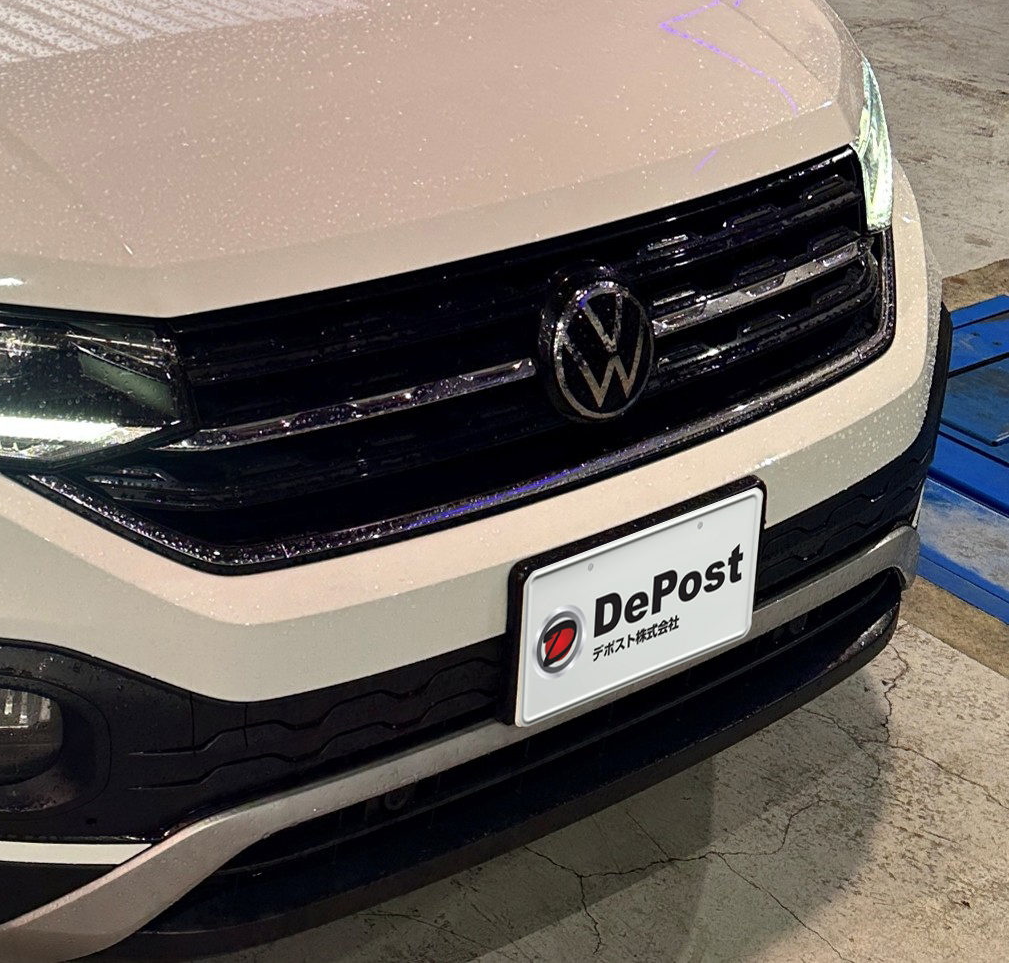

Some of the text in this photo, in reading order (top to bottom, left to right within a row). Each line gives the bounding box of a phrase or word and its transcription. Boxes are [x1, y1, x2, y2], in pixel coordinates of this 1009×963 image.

[593, 543, 744, 638] DePost
[593, 615, 680, 661] デポスト株式会社
